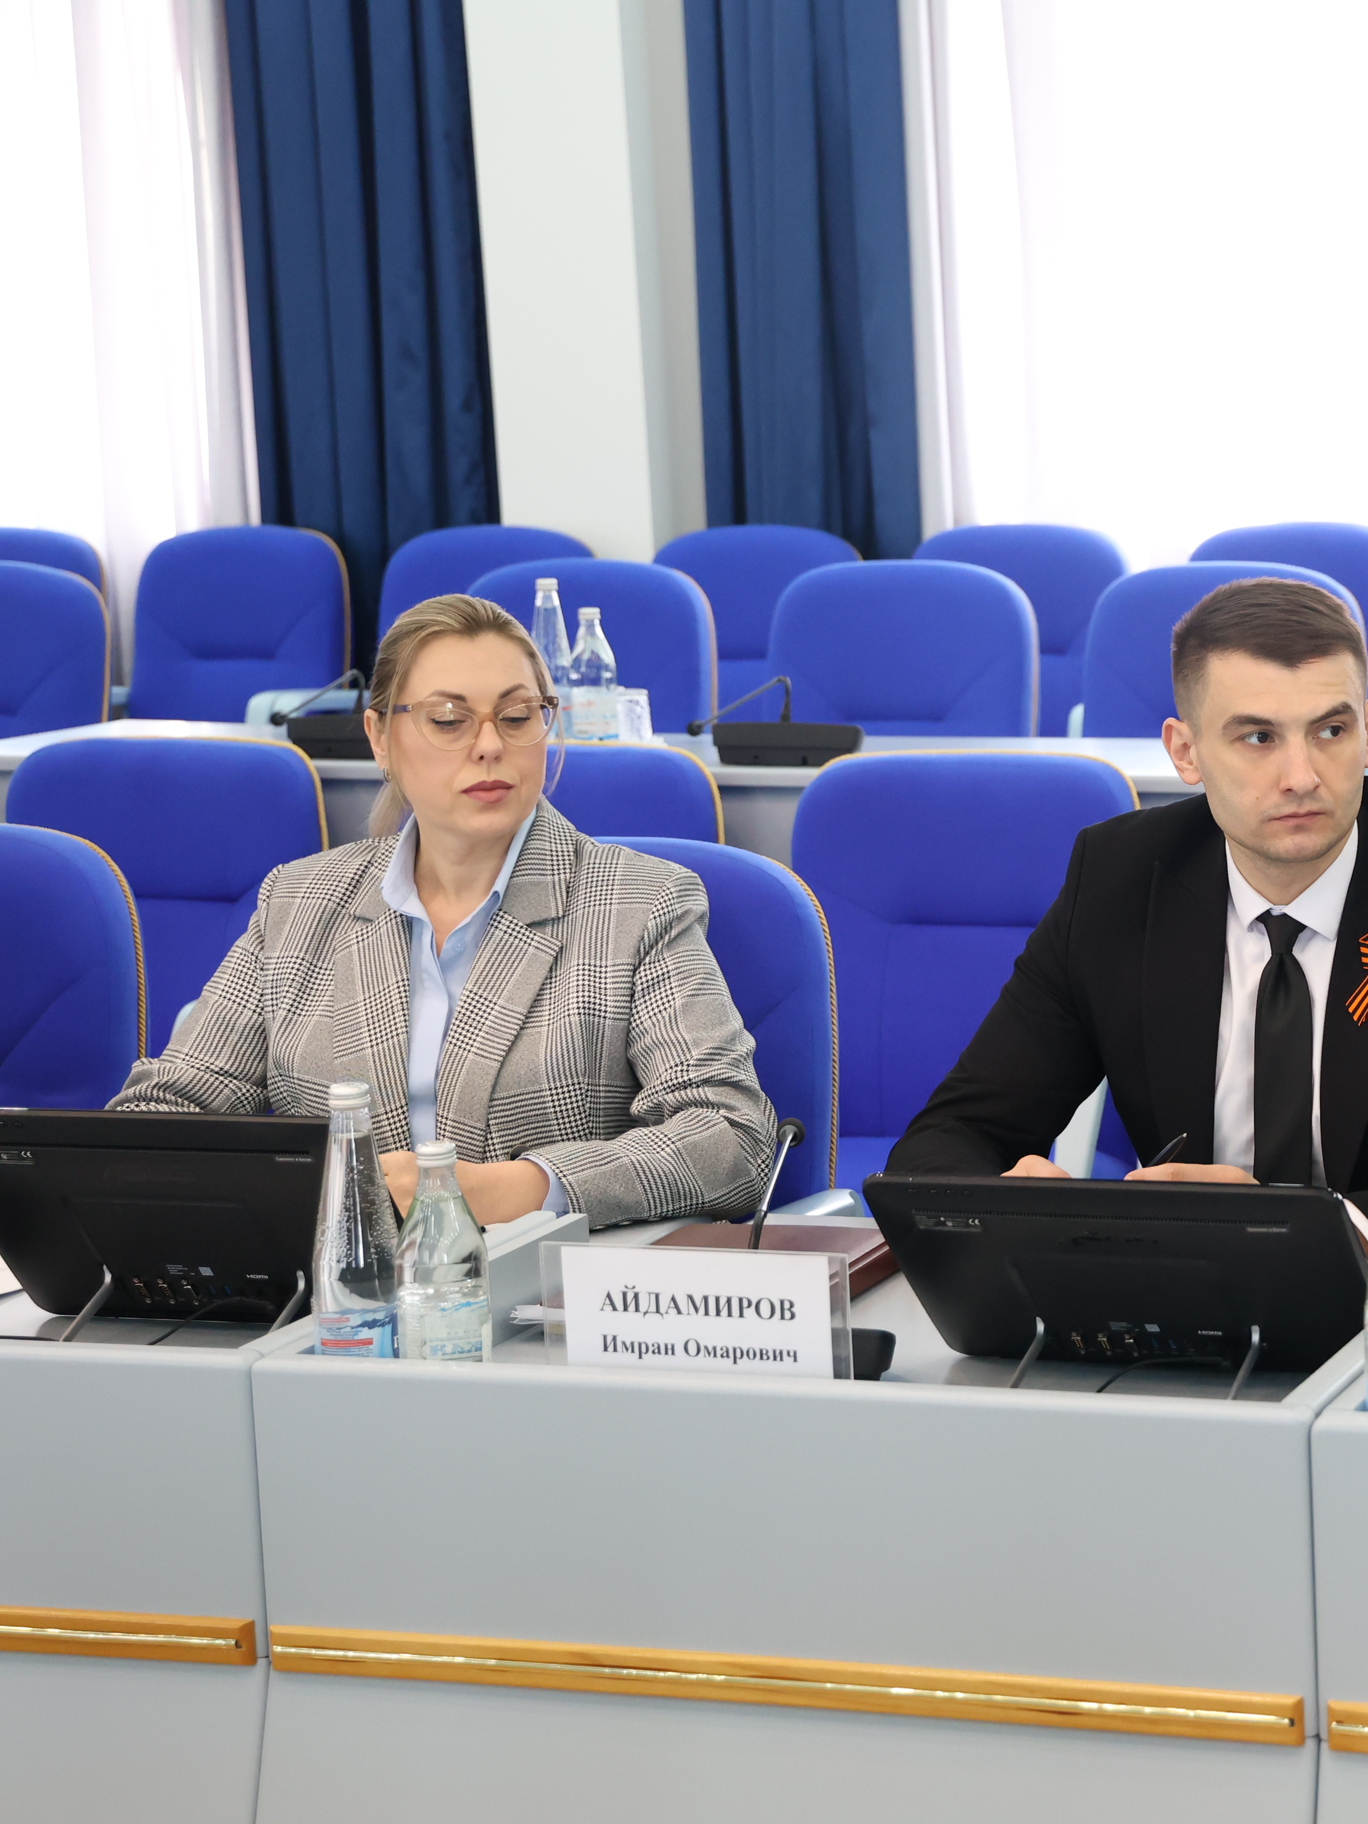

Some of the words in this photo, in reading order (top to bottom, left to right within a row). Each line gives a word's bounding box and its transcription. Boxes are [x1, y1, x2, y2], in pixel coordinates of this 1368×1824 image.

[600, 1284, 796, 1321] АЙДАМИРОВ
[601, 1334, 677, 1360] Имран
[682, 1338, 799, 1365] Омарович
